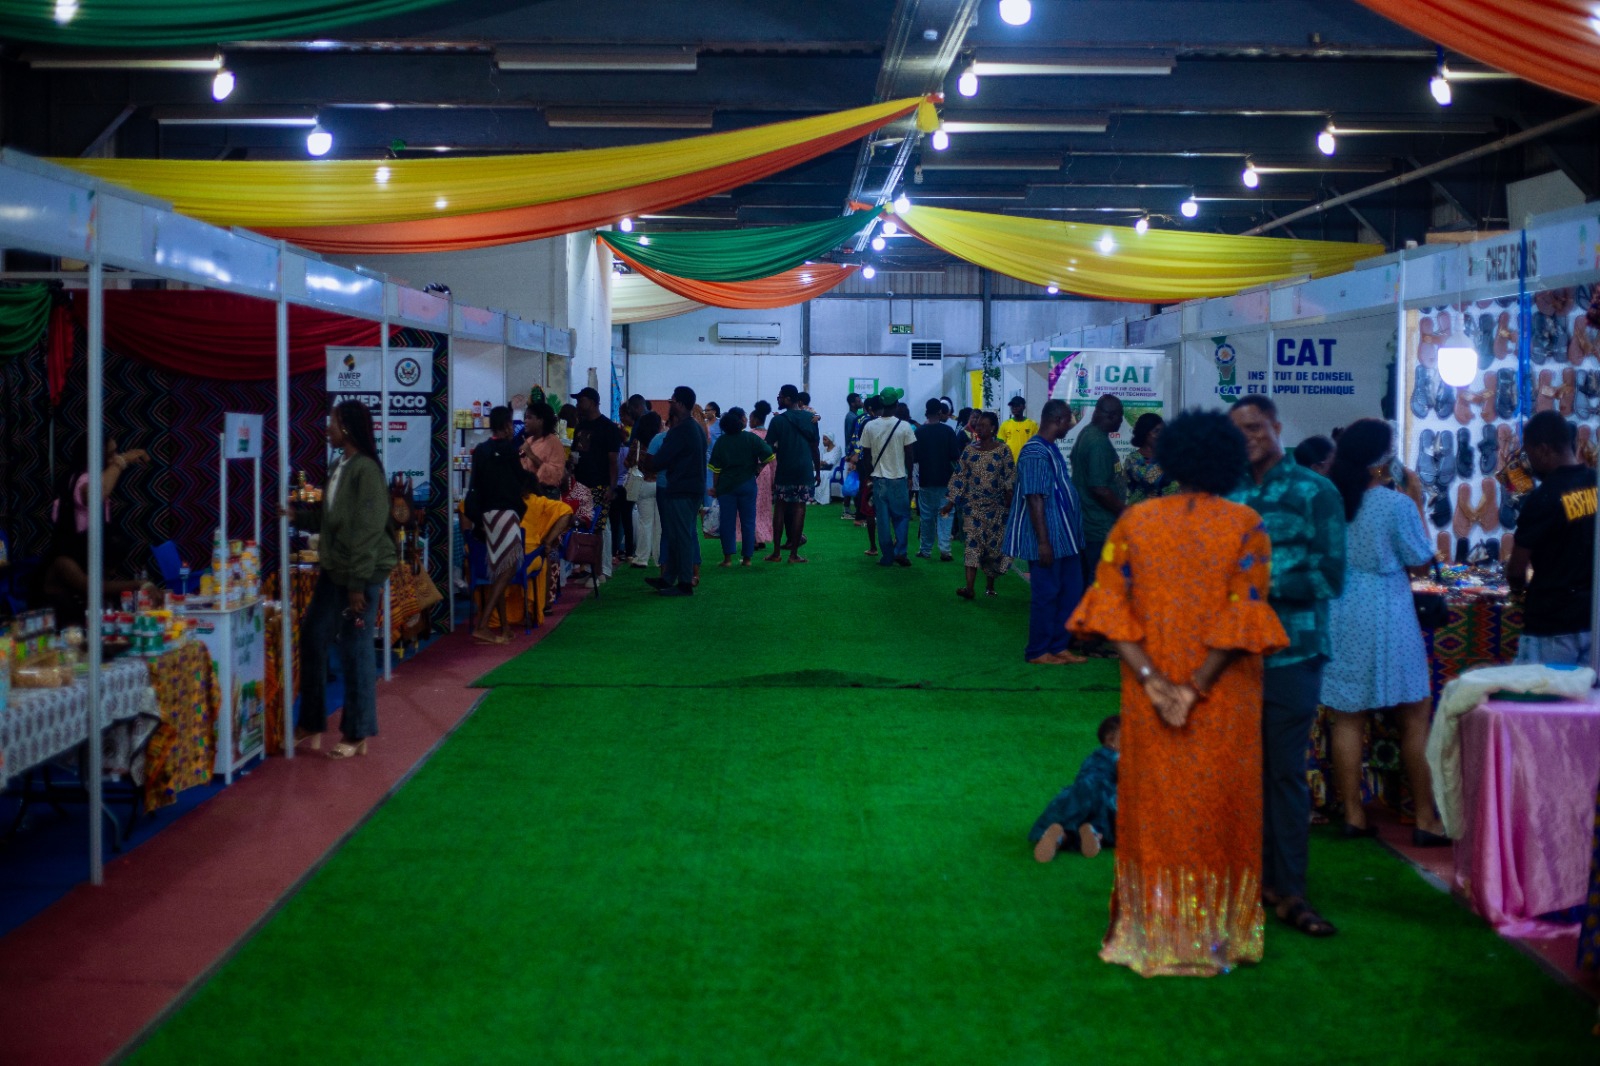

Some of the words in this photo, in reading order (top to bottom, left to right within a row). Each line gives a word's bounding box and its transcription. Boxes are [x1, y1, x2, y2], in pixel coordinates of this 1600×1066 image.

[1486, 246, 1508, 283] CHEZ
[1277, 338, 1337, 366] CAT
[1095, 365, 1153, 383] ICAT
[1248, 370, 1291, 381] INSTUT
[1295, 371, 1308, 381] DE
[1311, 371, 1354, 382] CONSEIL
[1214, 386, 1242, 394] ICAT
[1247, 384, 1258, 394] ET
[1303, 385, 1355, 395] TECHNIQUE
